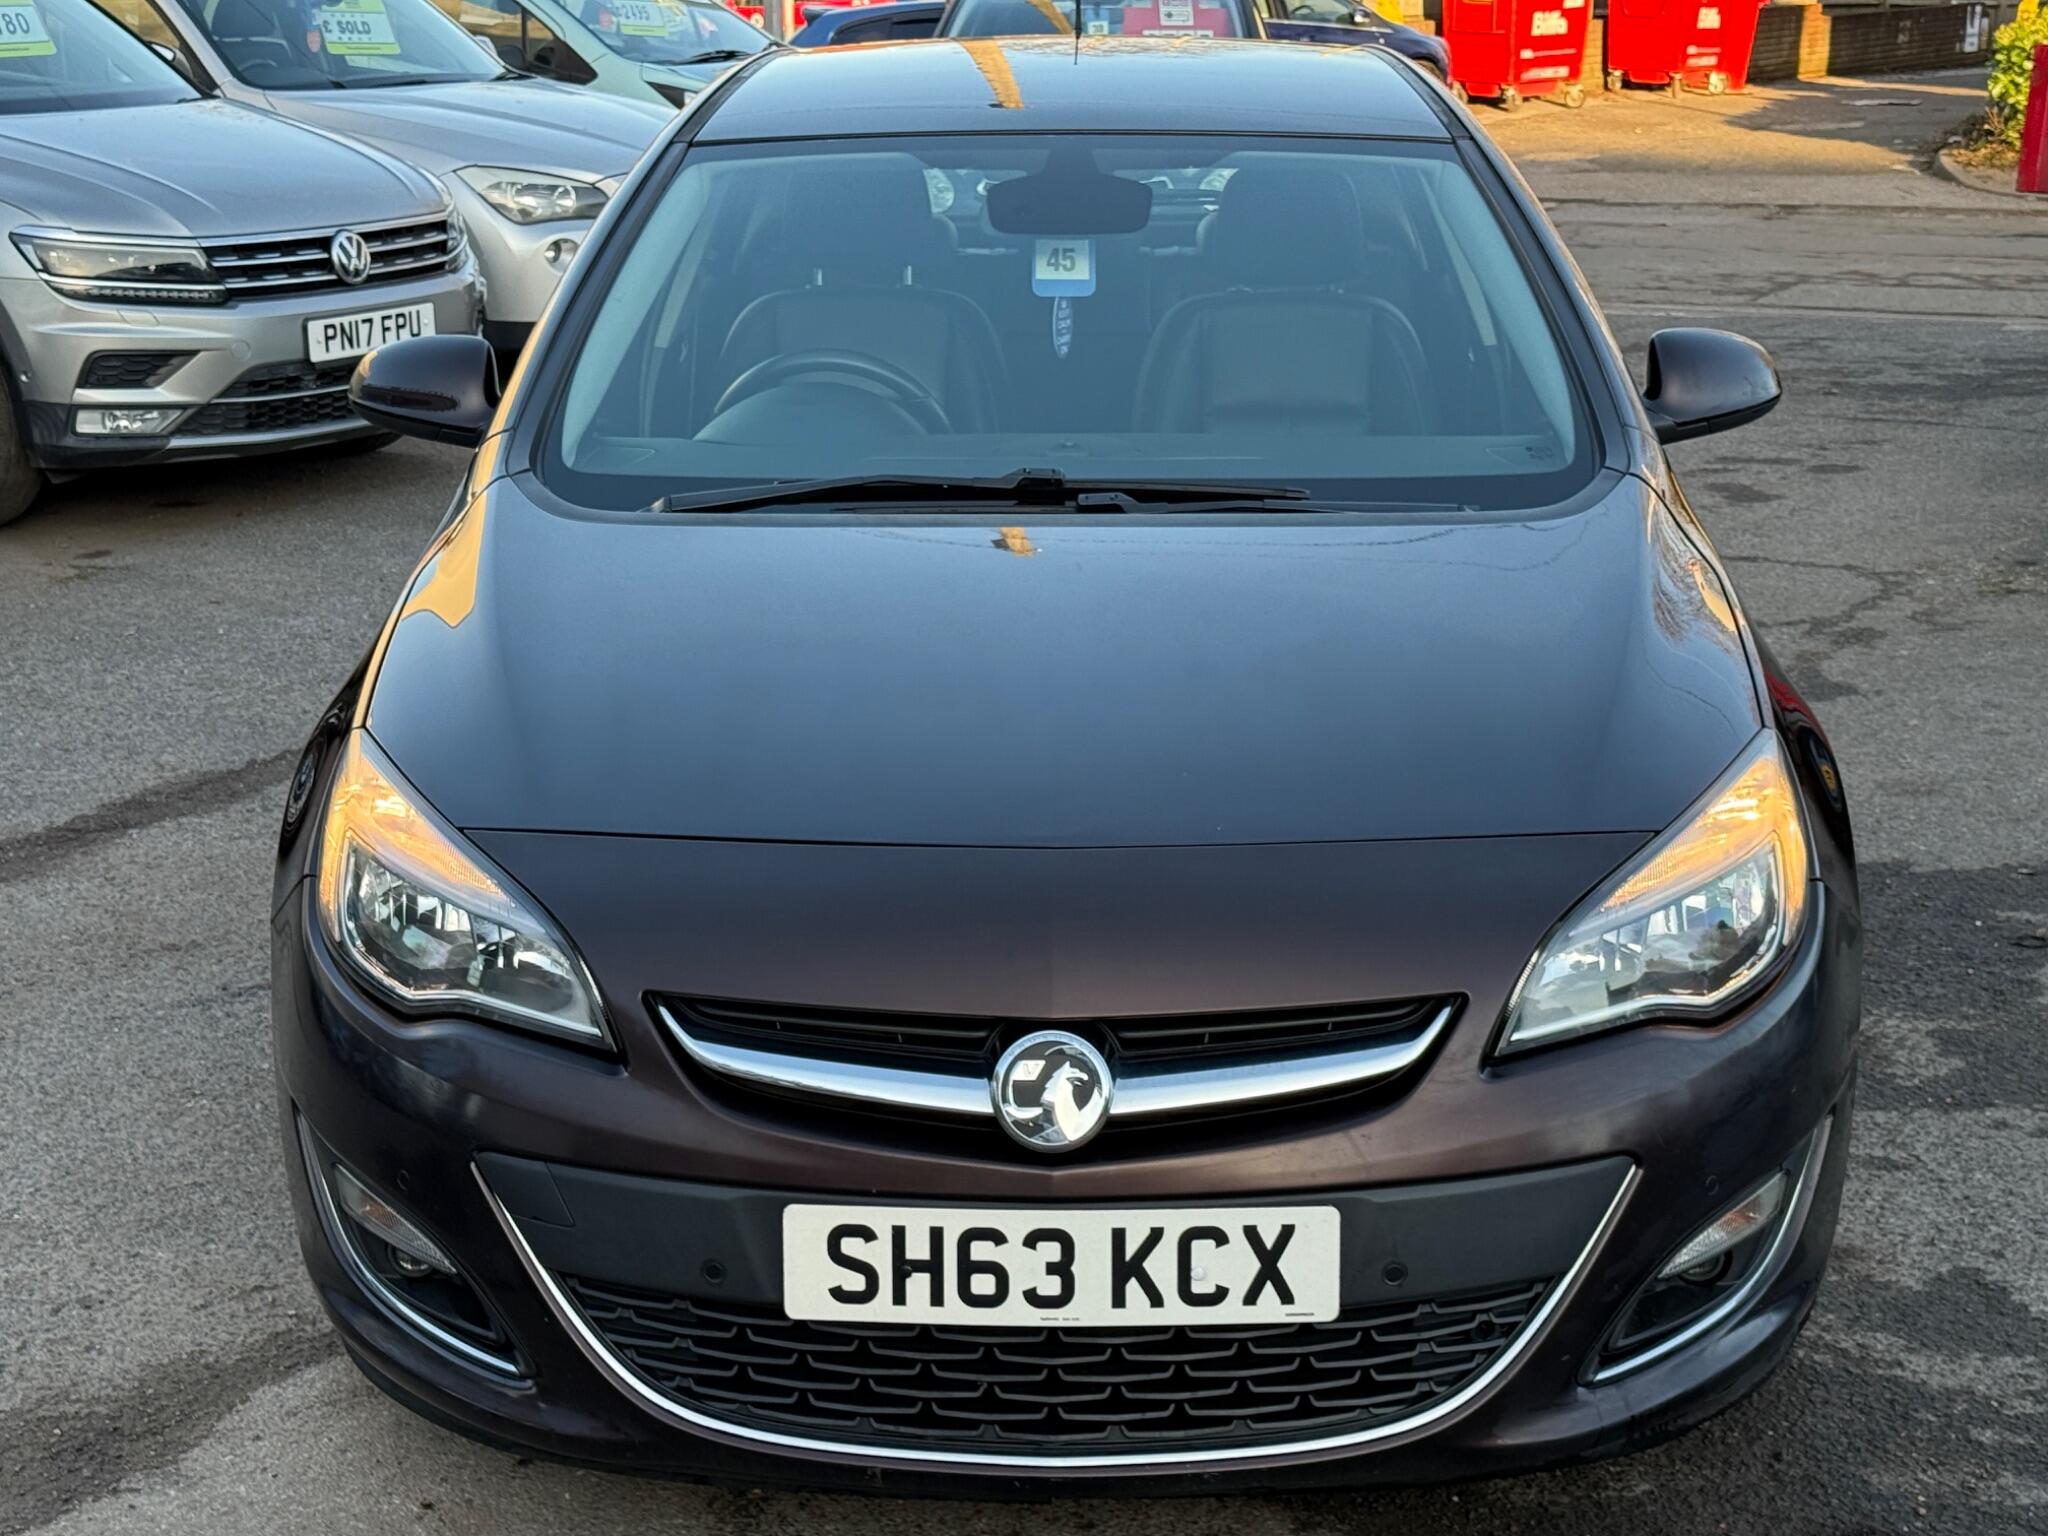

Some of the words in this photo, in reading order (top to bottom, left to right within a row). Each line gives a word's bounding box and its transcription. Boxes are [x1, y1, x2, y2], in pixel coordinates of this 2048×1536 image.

[0, 12, 30, 35] 80
[336, 20, 371, 34] SOLD
[1046, 247, 1076, 272] 45
[323, 318, 374, 353] PN17
[380, 309, 421, 345] FPU
[826, 1223, 1076, 1309] SH63
[1110, 1223, 1296, 1309] KCX
